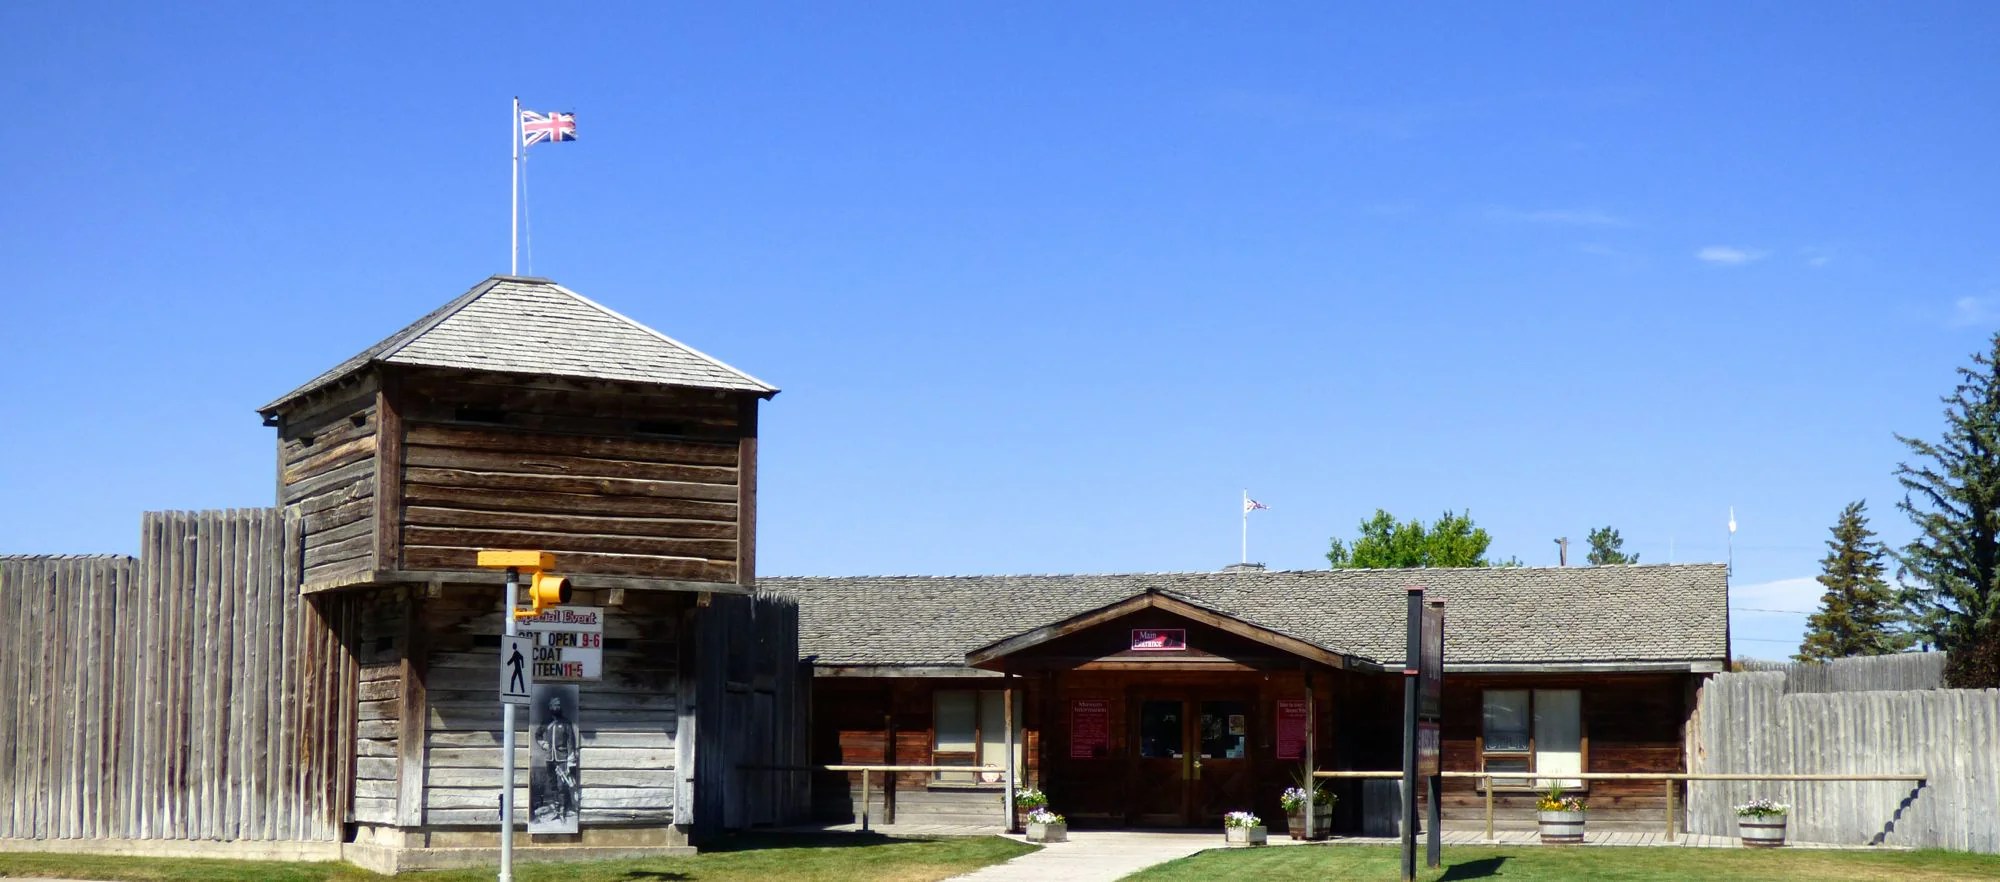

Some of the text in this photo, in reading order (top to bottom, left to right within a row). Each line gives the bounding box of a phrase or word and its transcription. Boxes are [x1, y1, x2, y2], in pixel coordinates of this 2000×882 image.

[562, 610, 597, 624] Event
[548, 632, 577, 647] OPEN
[582, 632, 600, 648] 9-6
[1140, 631, 1157, 639] Main
[532, 648, 562, 661] COAT
[532, 663, 583, 678] TEEN 11-5
